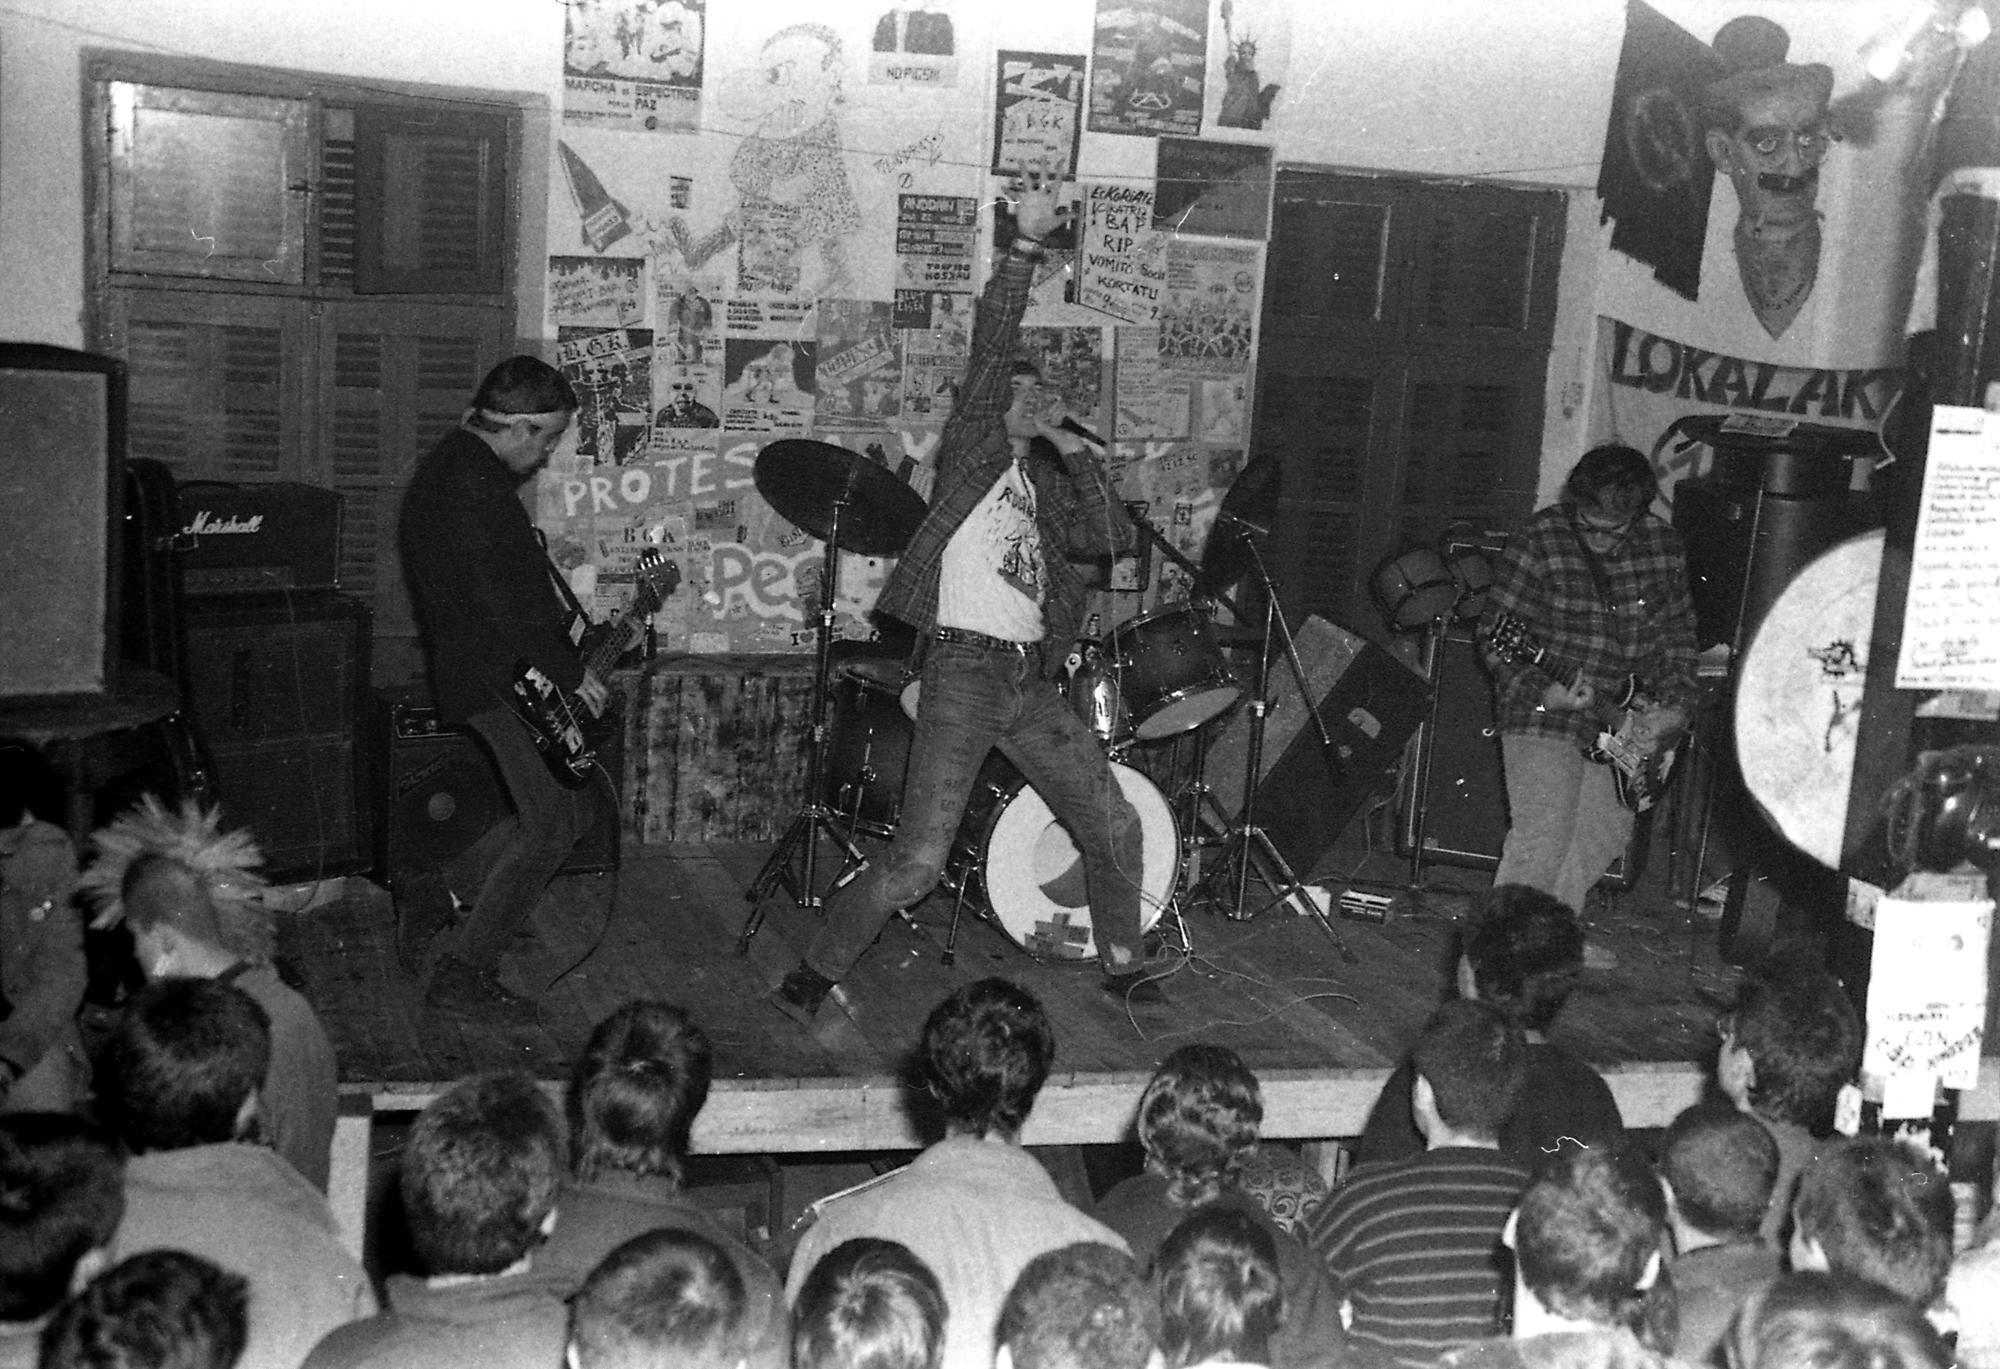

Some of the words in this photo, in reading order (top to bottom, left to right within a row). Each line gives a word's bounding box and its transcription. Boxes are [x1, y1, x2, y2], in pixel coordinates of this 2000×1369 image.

[1104, 234, 1133, 252] RIP
[1089, 254, 1133, 274] VOMITO
[1098, 276, 1159, 299] KORTATU
[183, 510, 264, 534] Marshall
